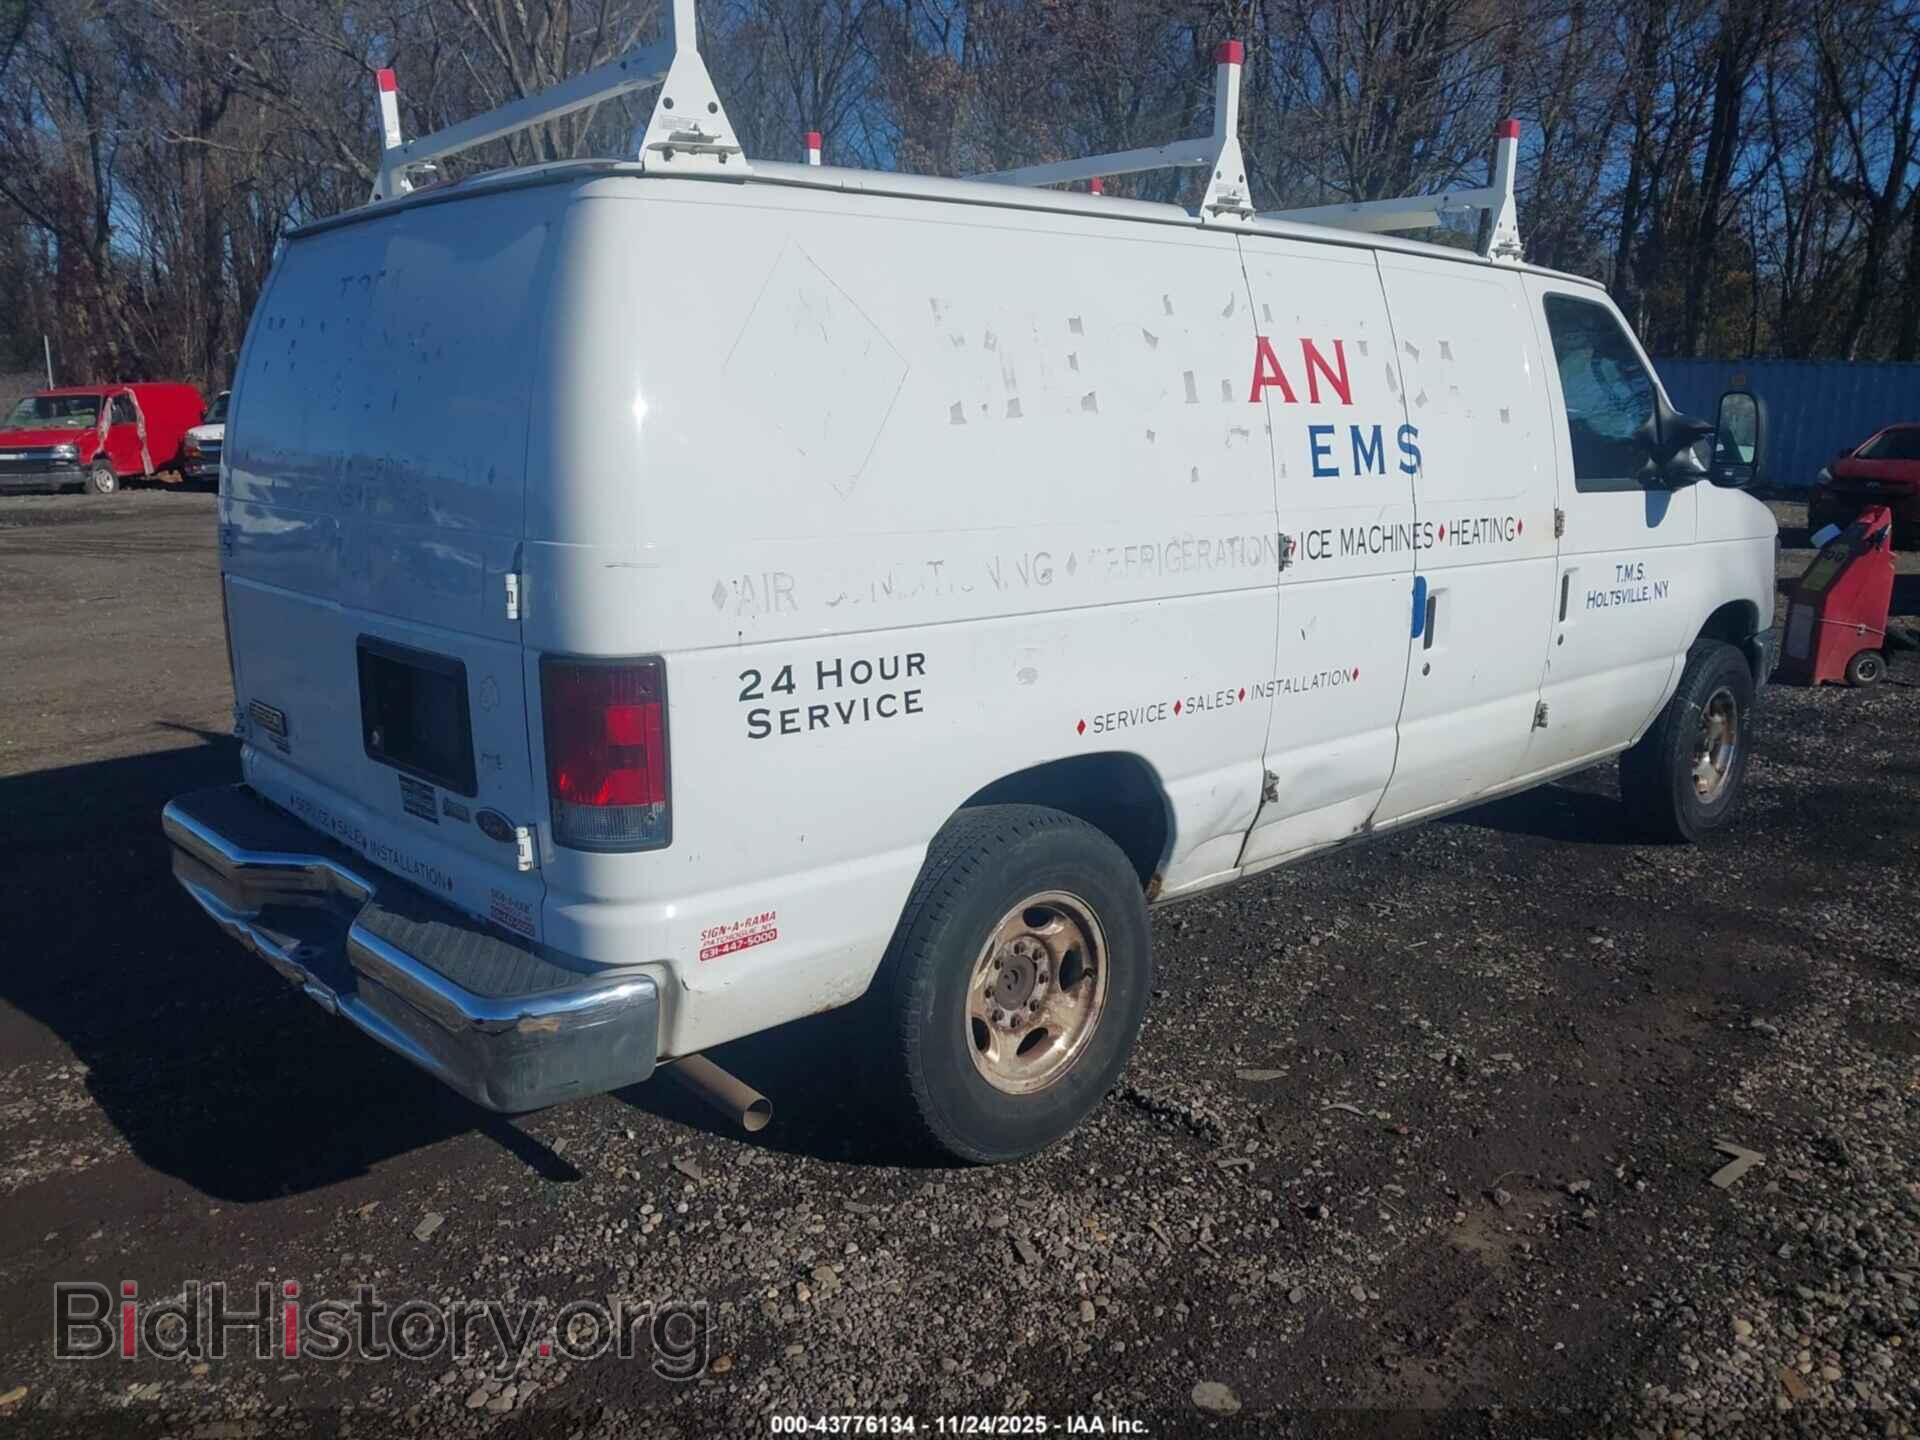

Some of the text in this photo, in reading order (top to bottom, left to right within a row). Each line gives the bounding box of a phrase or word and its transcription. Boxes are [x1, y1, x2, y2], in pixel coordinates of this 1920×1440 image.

[1249, 335, 1354, 406] AN
[1308, 424, 1422, 479] EMS
[1299, 528, 1333, 561] ICE
[1340, 521, 1434, 557] MACHINES
[1448, 516, 1515, 547] HEATING
[1654, 580, 1670, 600] NY
[738, 652, 927, 702] 24 HOUR
[1092, 668, 1352, 735] SERVICE SALES INSTALLATION
[746, 689, 924, 740] SERVICE
